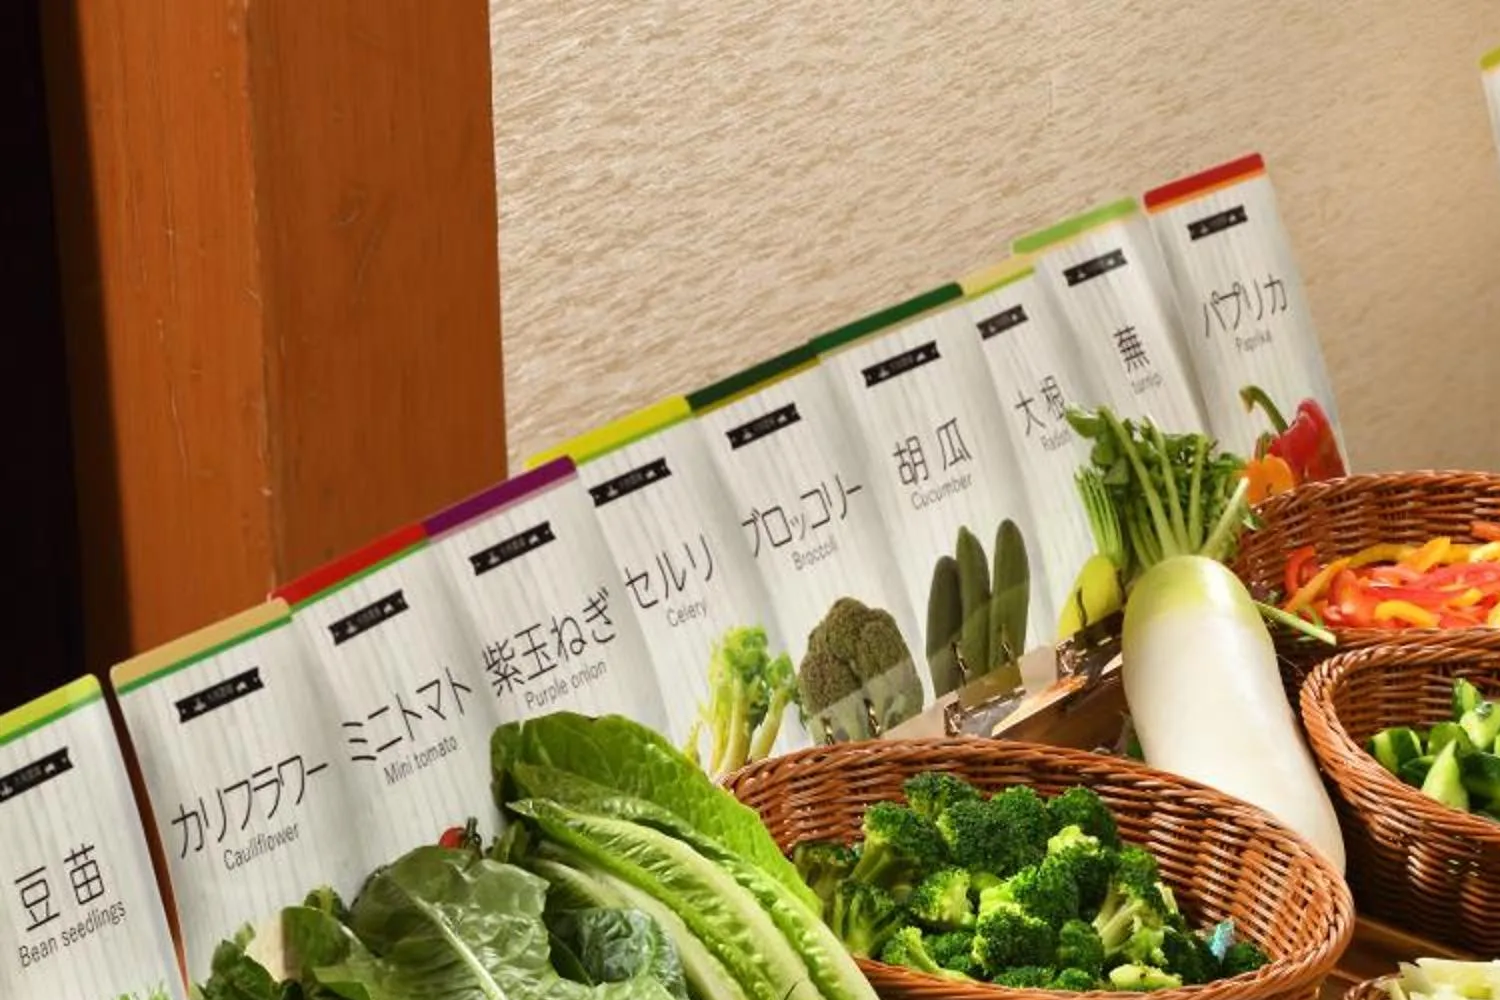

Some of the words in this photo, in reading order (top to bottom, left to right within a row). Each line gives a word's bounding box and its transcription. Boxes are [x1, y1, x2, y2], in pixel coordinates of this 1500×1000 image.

[1203, 274, 1288, 338] パプリカ
[1113, 325, 1150, 373] 蕪
[1015, 375, 1066, 436] 大根
[892, 417, 973, 486] 胡瓜
[741, 473, 863, 558] ブロッコリー
[910, 473, 973, 510] Cucumber
[625, 533, 713, 609] セルリ
[482, 586, 617, 697] 紫玉ねぎ
[666, 602, 708, 628] Celery
[341, 666, 473, 762] ミニトマト
[523, 678, 569, 710] Purple
[570, 658, 608, 688] onion
[382, 760, 413, 786] Mini
[412, 736, 460, 770] tomato
[171, 754, 328, 860] カリフラワー
[223, 823, 299, 871] Cauliflower
[14, 843, 106, 932] 豆苗
[18, 935, 58, 968] Bean
[61, 901, 127, 948] seedlings
